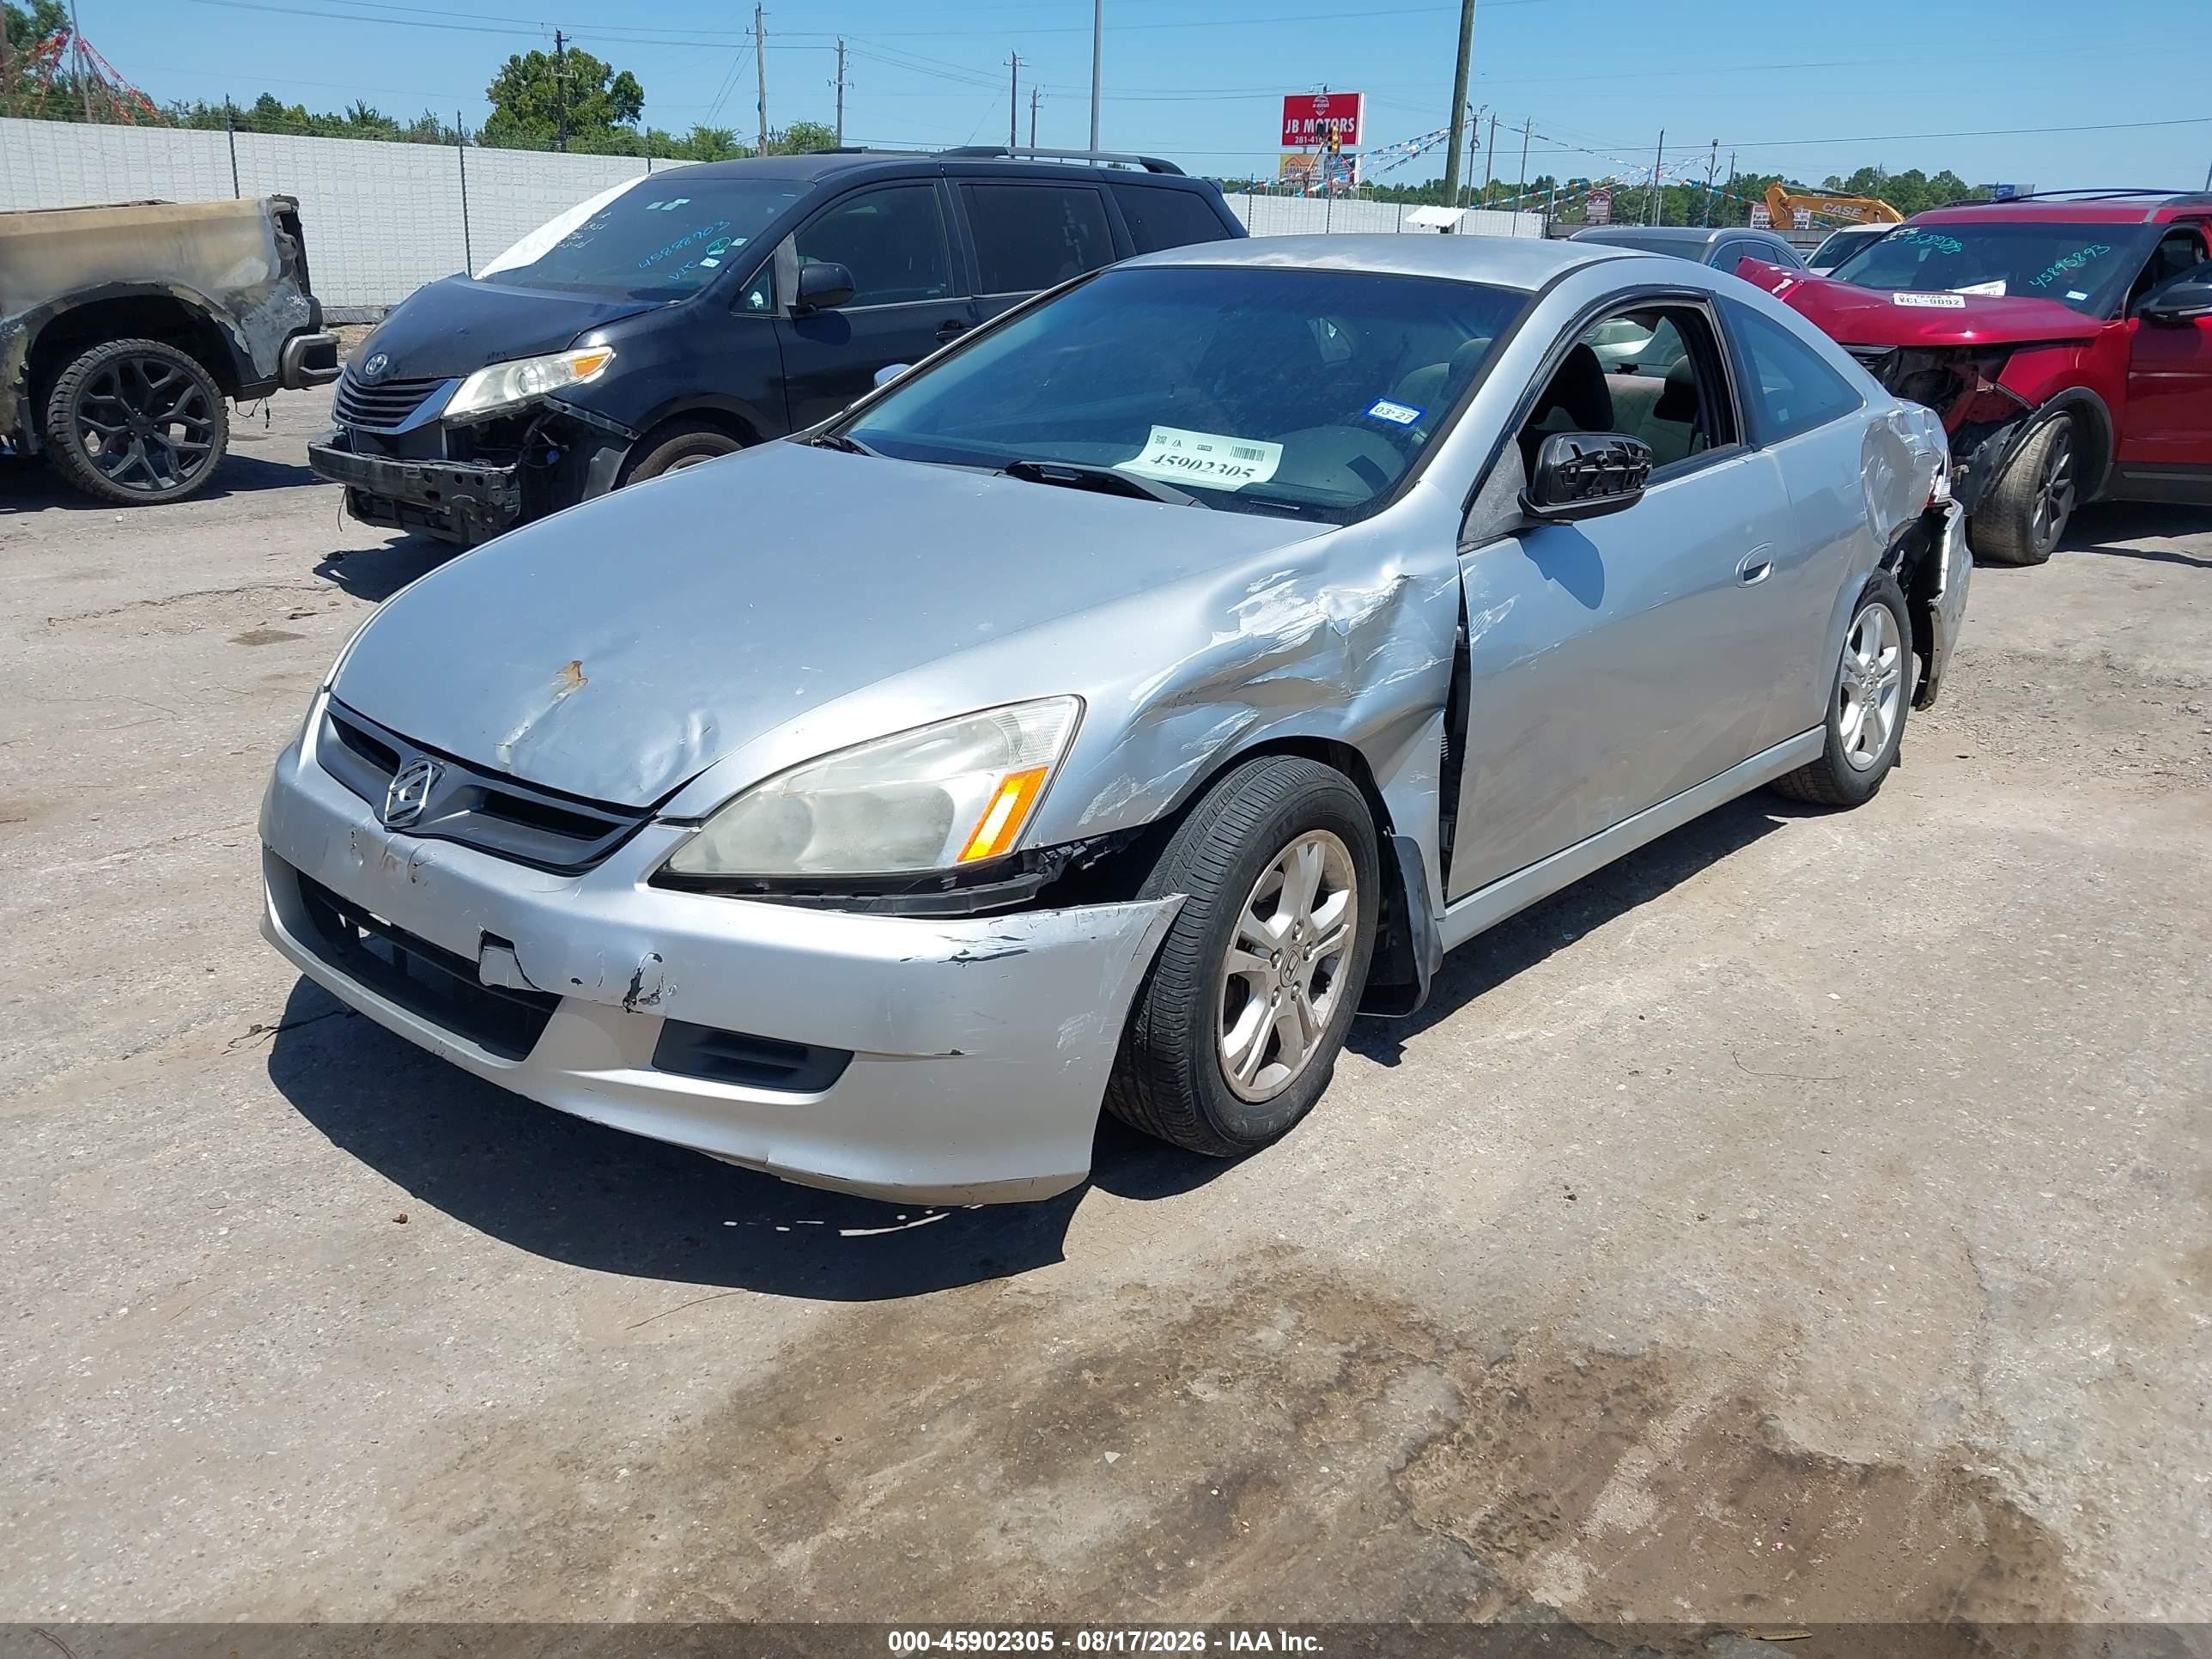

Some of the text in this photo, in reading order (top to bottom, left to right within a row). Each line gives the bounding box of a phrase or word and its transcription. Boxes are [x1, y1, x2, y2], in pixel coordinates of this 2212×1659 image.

[1285, 119, 1299, 134] JB
[1822, 203, 1863, 217] CASE
[2029, 245, 2111, 288] 45895893
[1151, 453, 1256, 478] 45902305
